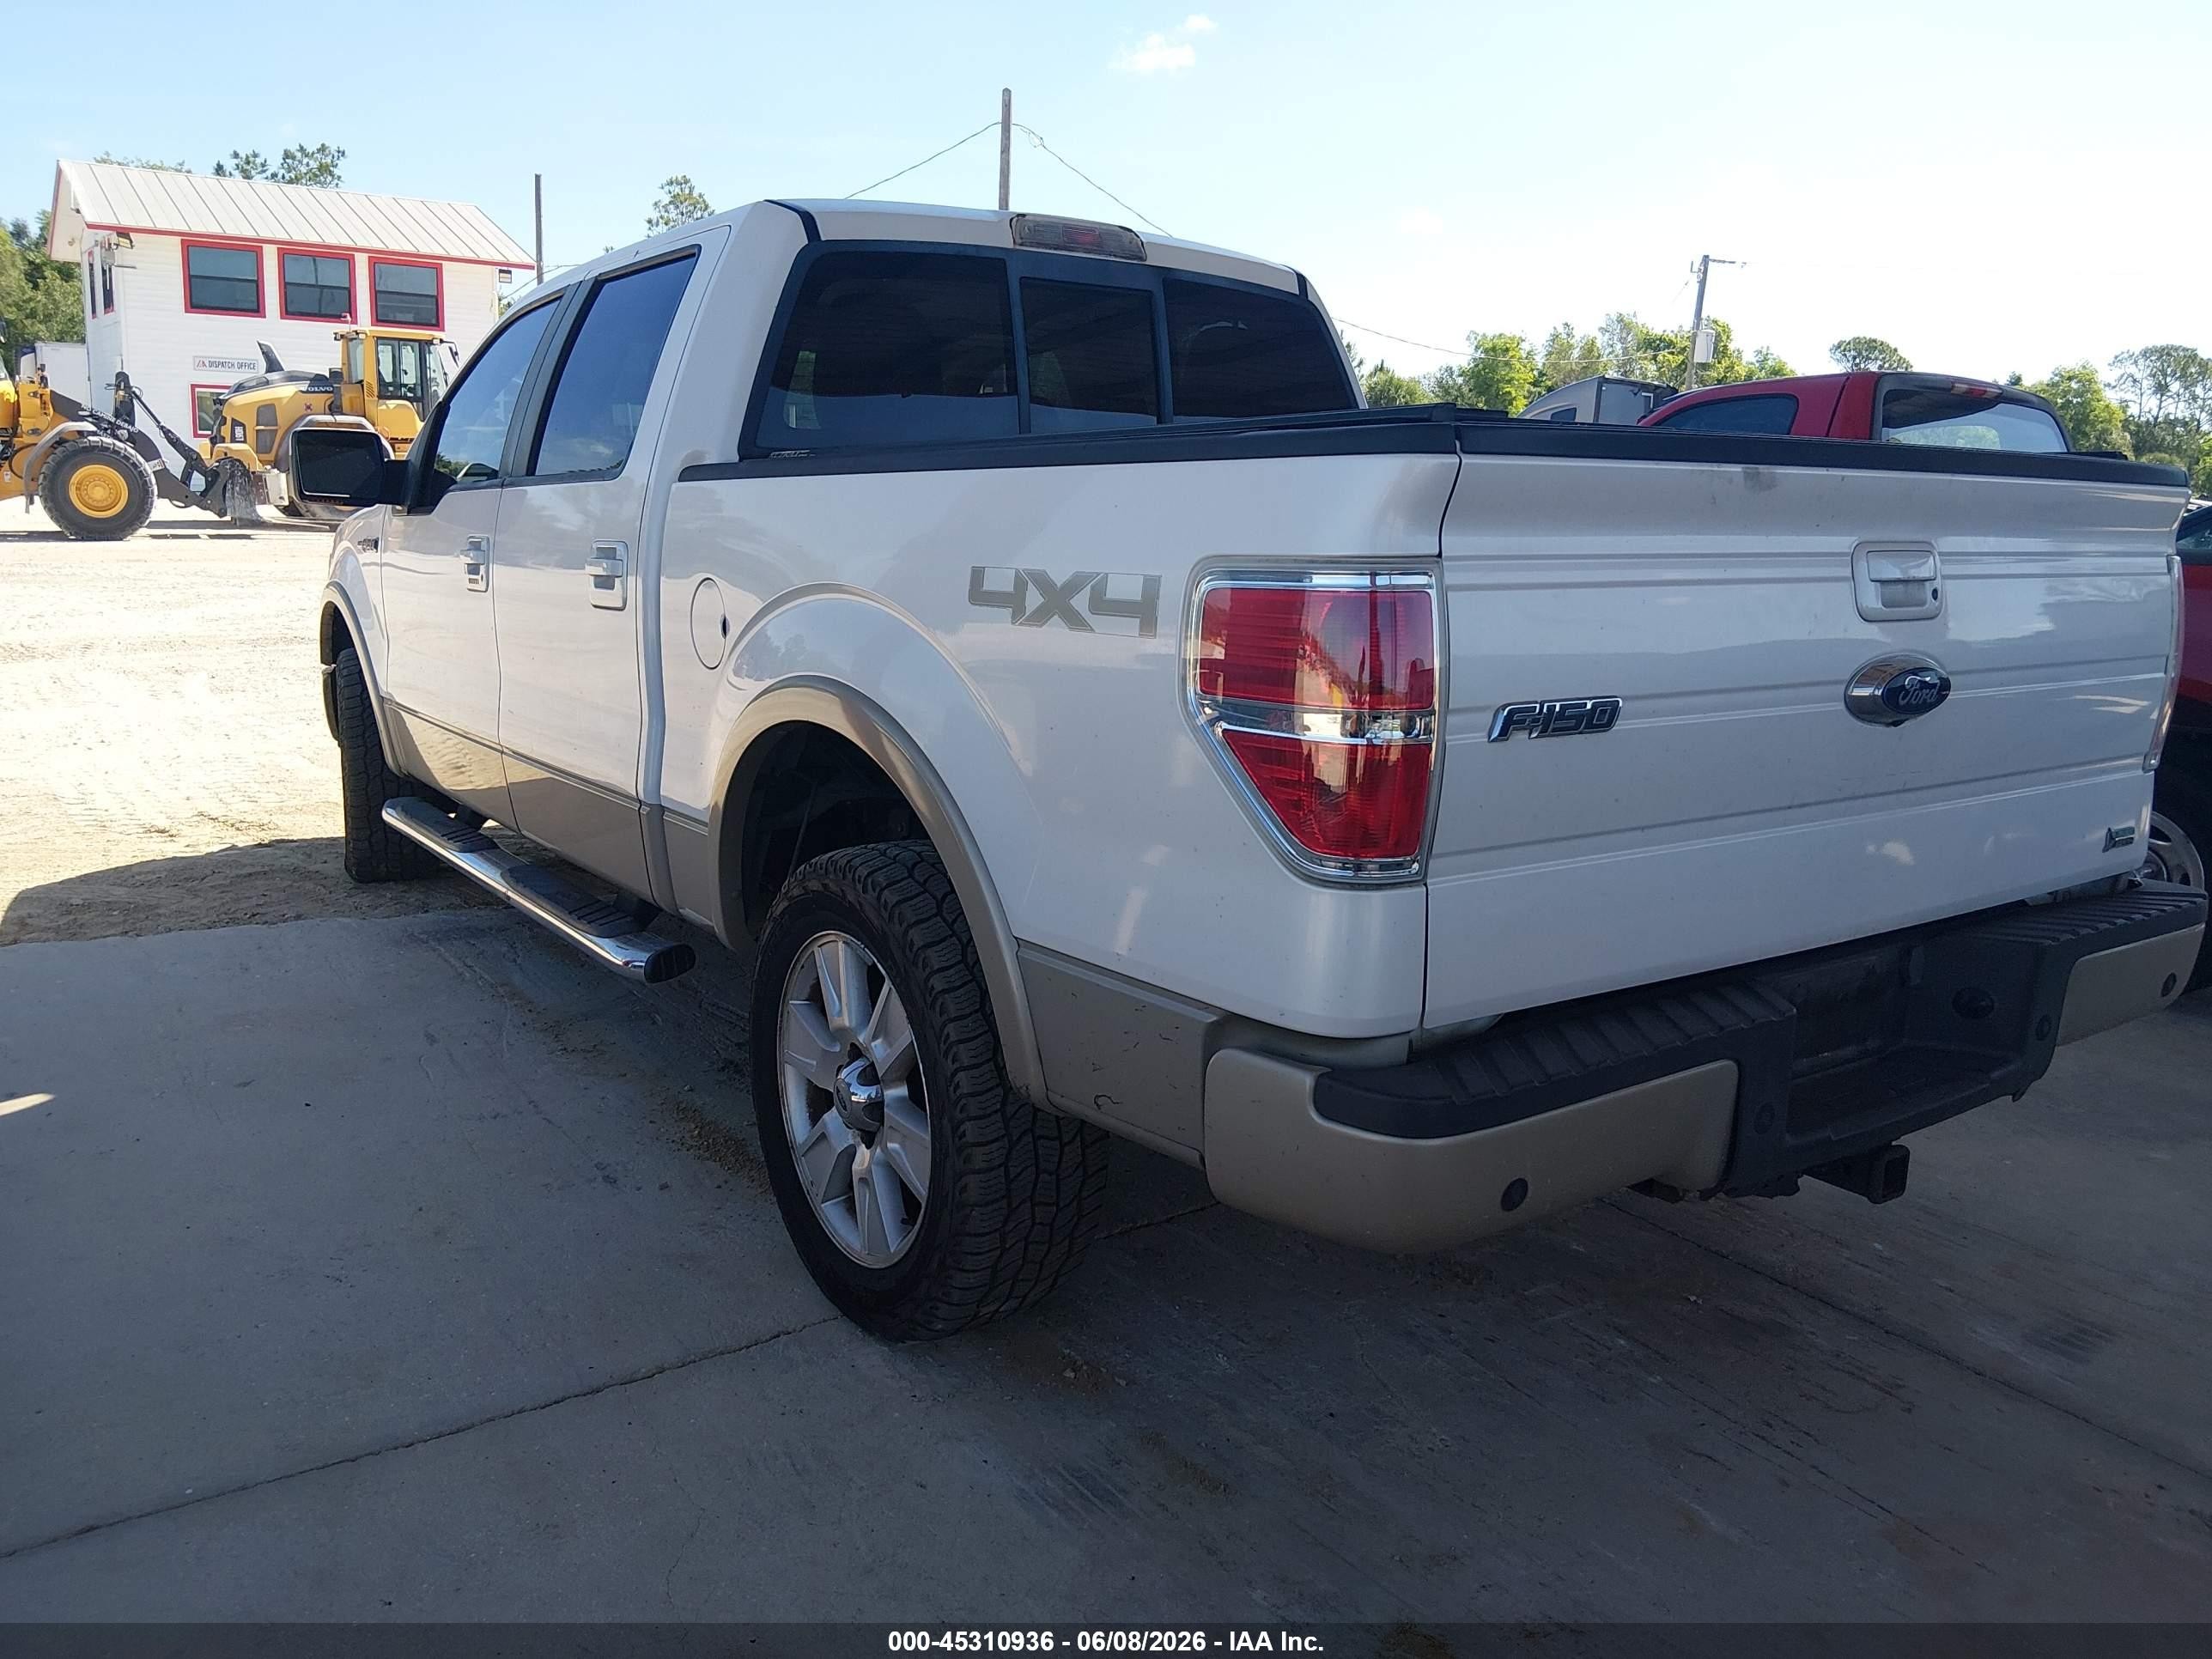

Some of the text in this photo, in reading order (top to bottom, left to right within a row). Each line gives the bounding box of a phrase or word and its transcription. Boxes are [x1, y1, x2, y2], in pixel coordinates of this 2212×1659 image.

[208, 360, 235, 370] DISPATCH
[236, 362, 257, 371] OFFICE
[969, 566, 1163, 639] 4X4
[1898, 675, 1941, 706] Ford
